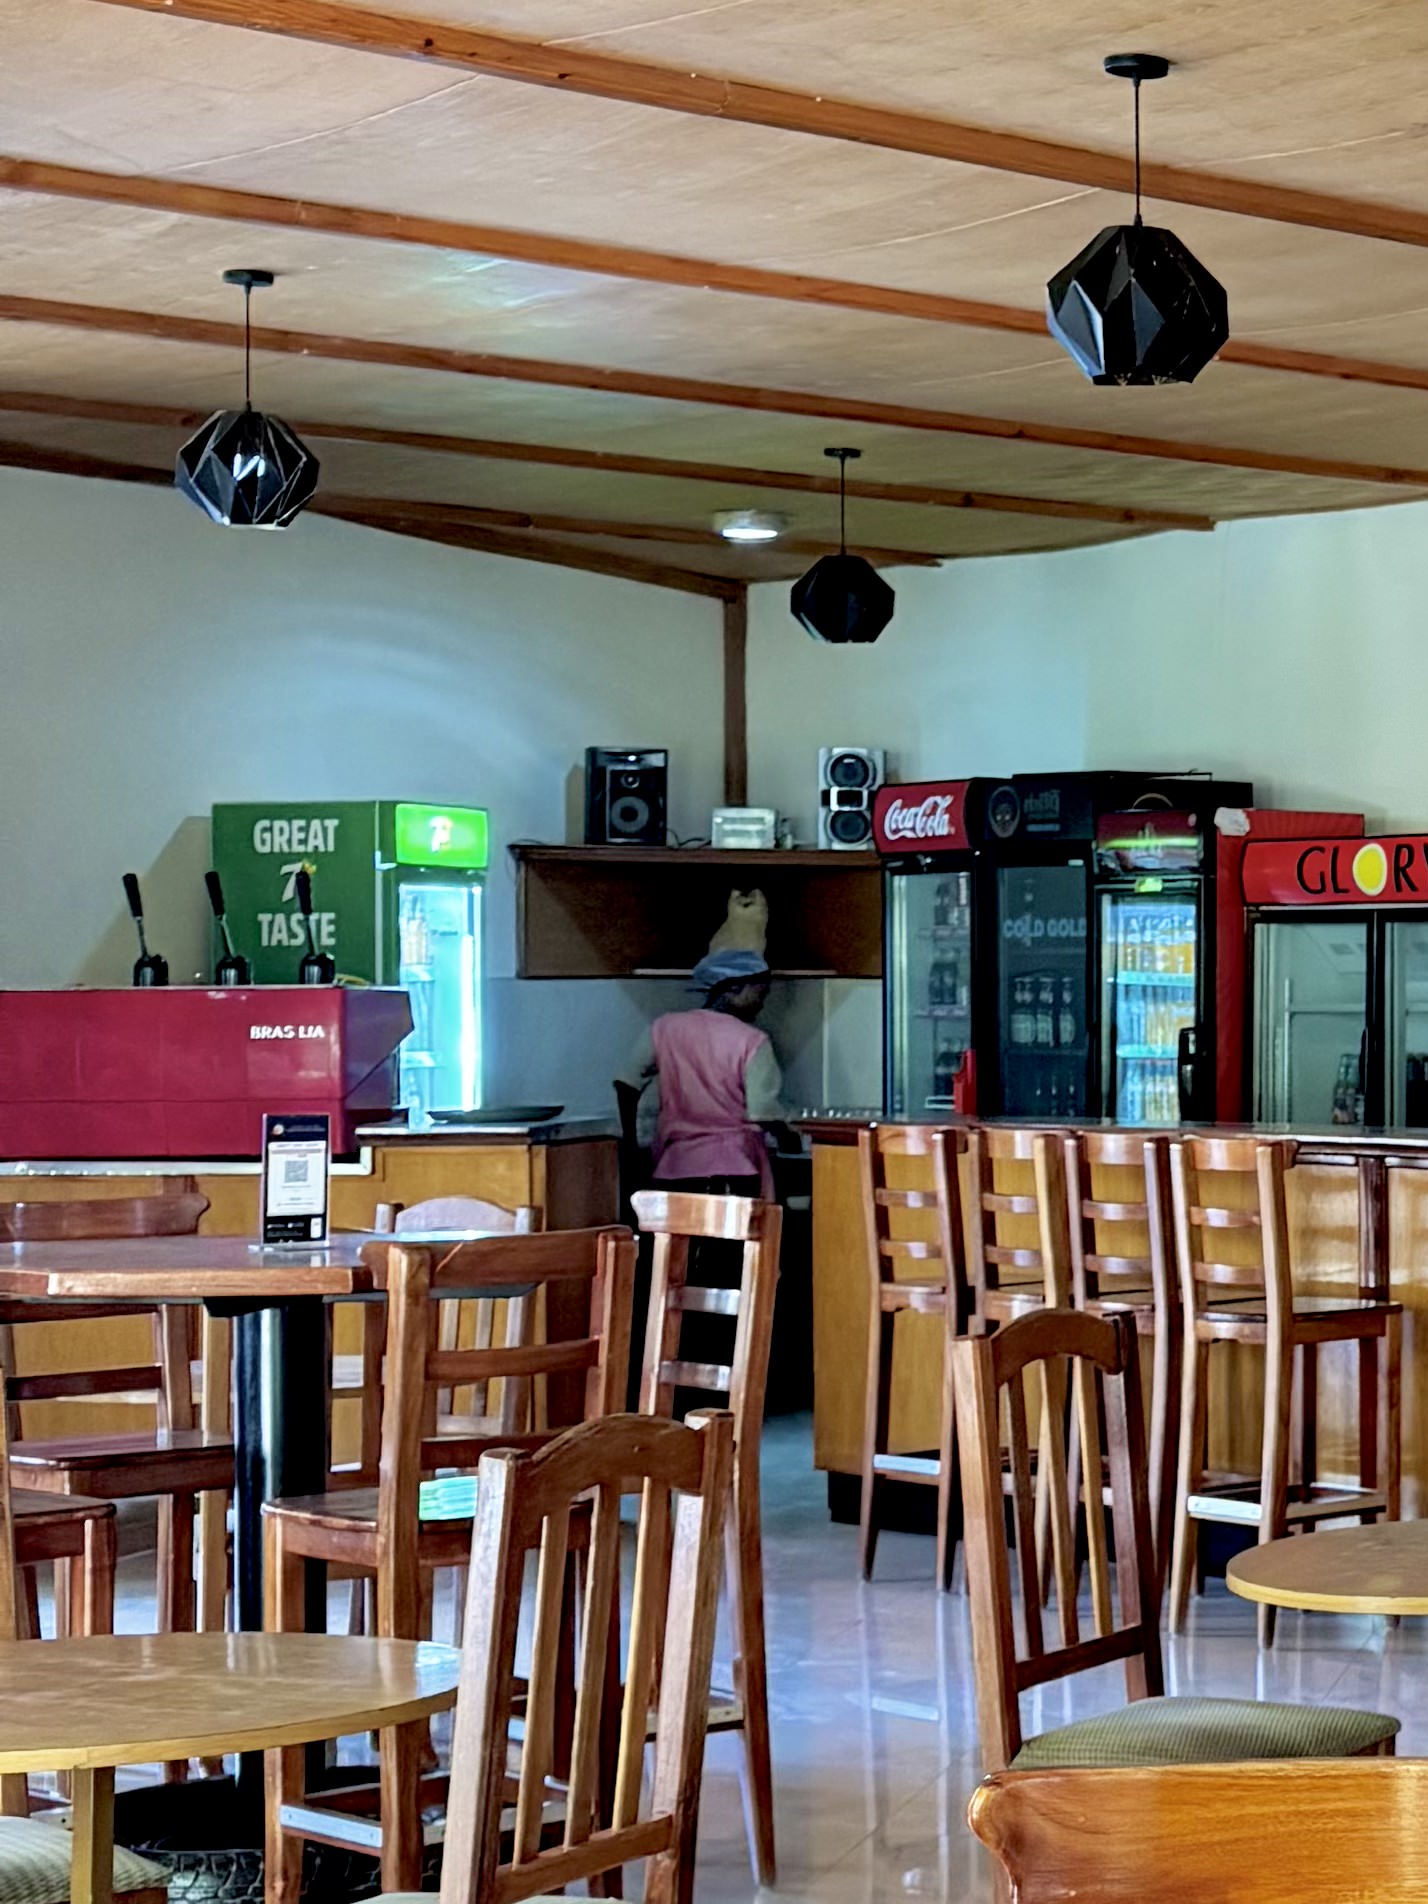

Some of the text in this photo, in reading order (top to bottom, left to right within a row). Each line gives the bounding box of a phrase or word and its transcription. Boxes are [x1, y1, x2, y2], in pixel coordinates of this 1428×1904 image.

[884, 795, 954, 841] Coca-Cola
[253, 819, 339, 853] GREAT
[257, 912, 336, 946] TASTE
[1003, 916, 1086, 939] COLD GOLD
